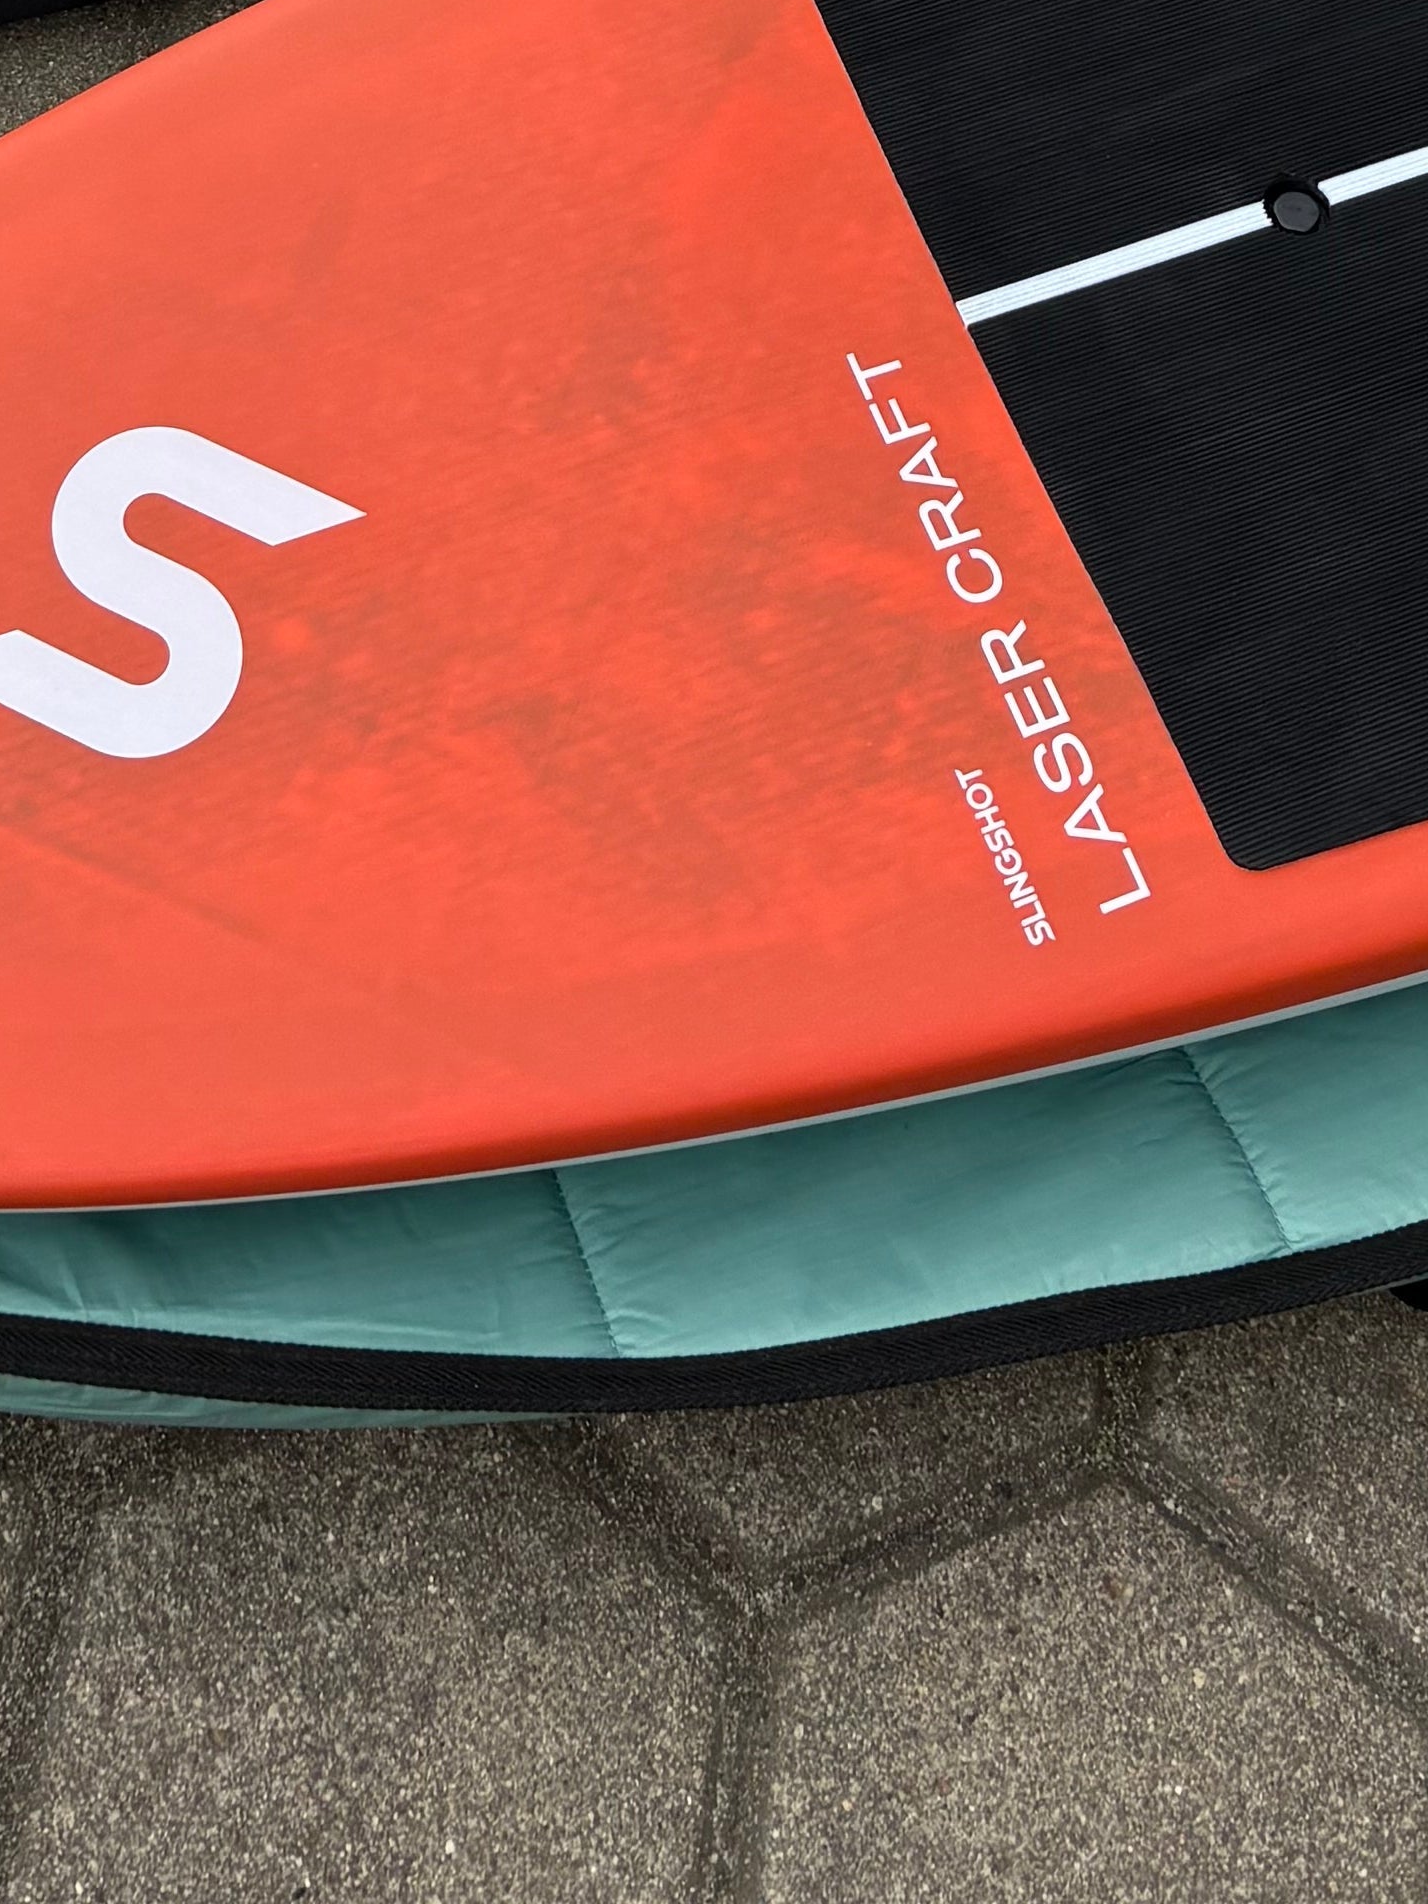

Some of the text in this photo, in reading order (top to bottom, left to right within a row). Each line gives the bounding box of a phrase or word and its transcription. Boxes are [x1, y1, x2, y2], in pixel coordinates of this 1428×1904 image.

[846, 352, 1152, 915] LASER CRAFT
[954, 768, 1056, 947] SLINGSHOT
